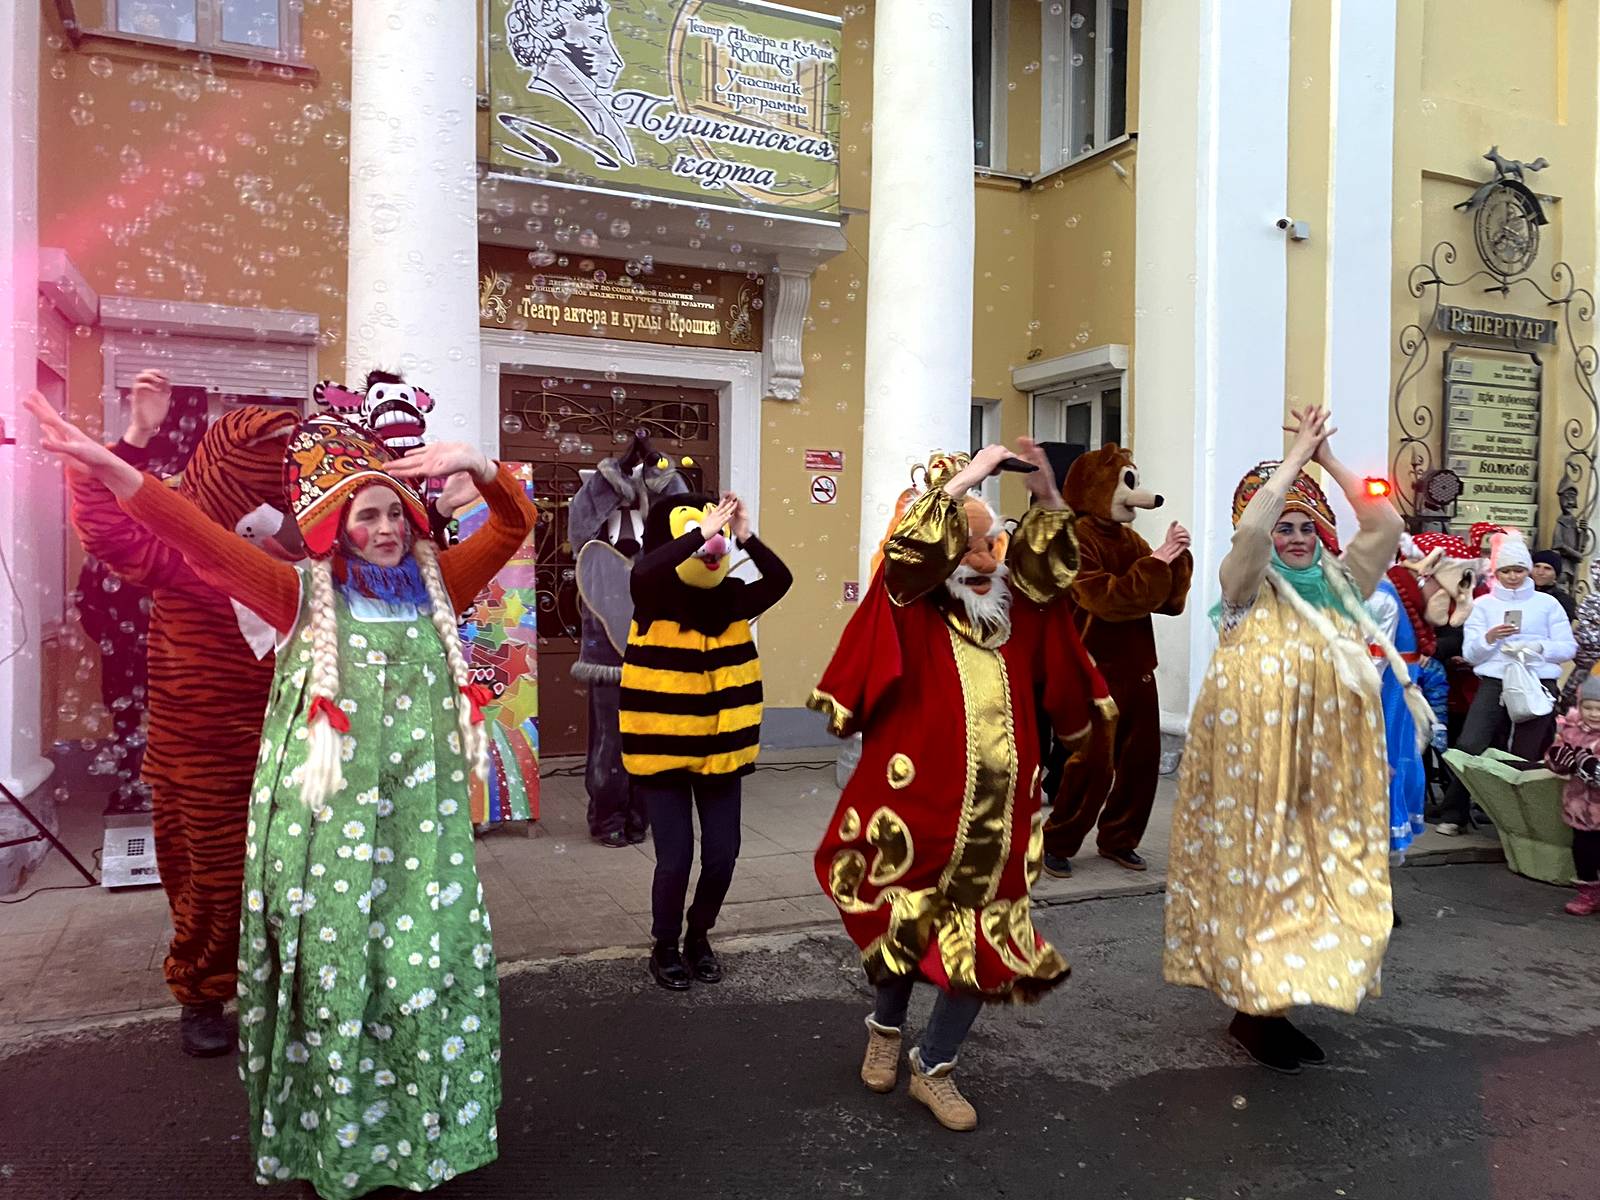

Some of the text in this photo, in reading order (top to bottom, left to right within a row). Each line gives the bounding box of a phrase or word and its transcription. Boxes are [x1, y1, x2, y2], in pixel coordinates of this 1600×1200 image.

[687, 18, 833, 60] Театр Актёра и Куклы
[716, 69, 802, 96] Участник
[727, 93, 807, 114] программы
[611, 91, 834, 158] Пушкинская
[675, 156, 774, 187] карта
[681, 300, 715, 310] КУЛЬТУРЫ
[563, 306, 607, 329] актера
[623, 313, 662, 333] куклы
